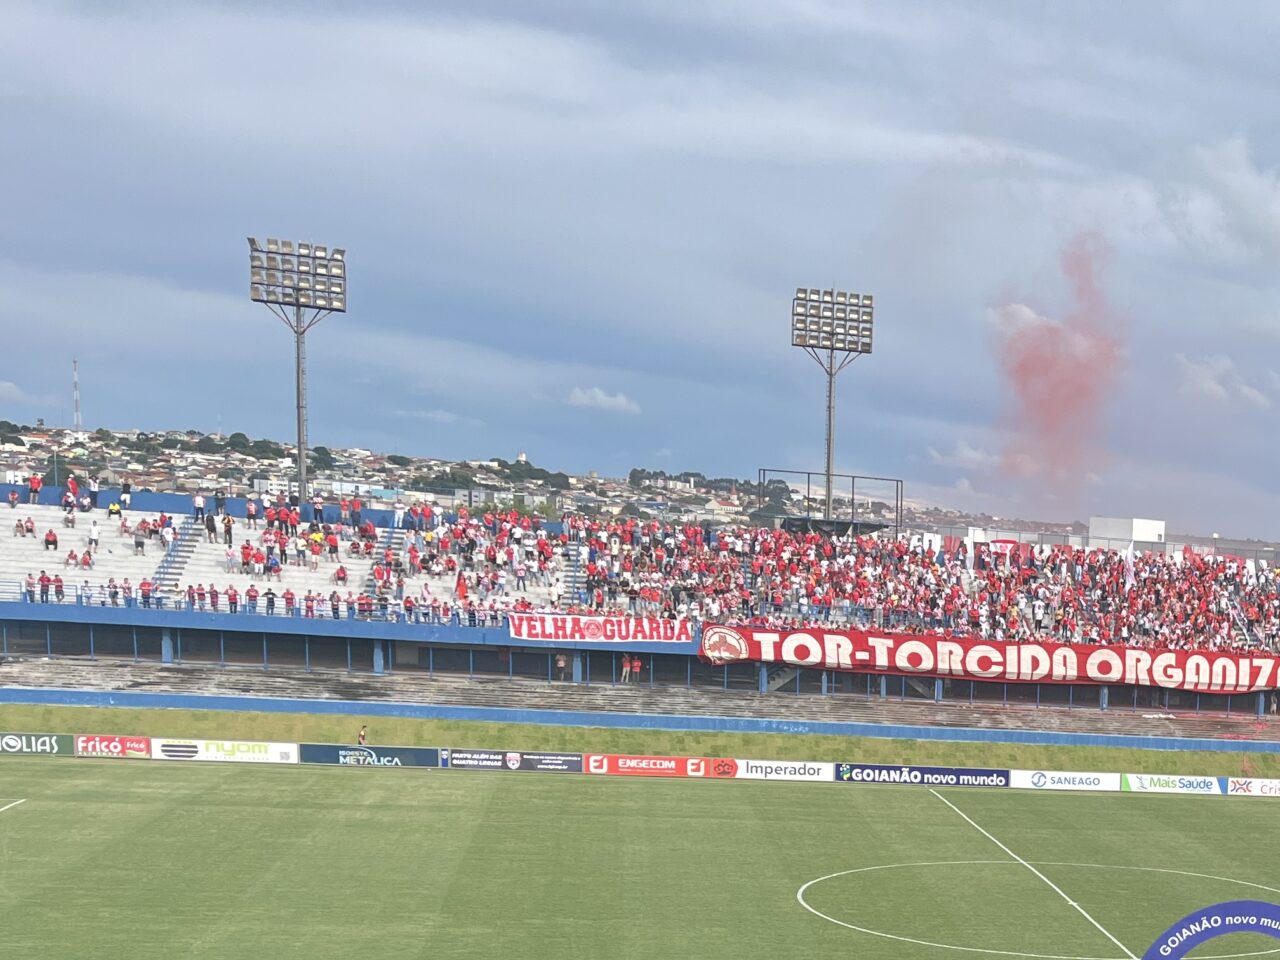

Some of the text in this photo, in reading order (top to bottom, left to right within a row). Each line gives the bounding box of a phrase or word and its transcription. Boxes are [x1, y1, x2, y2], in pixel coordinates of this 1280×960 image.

[510, 614, 692, 641] VELHA GUARDA
[752, 632, 1077, 680] TOR-TORCIDA
[77, 736, 122, 752] Fricó
[618, 758, 675, 769] ENGECOM
[745, 761, 822, 778] Imperador
[851, 767, 1005, 786] GOIANÃO novo mundo
[1050, 775, 1100, 786] SANEAGO
[1149, 777, 1213, 790] Mais Saúde
[1159, 916, 1221, 956] GOIANÃO
[1225, 916, 1258, 926] novo
